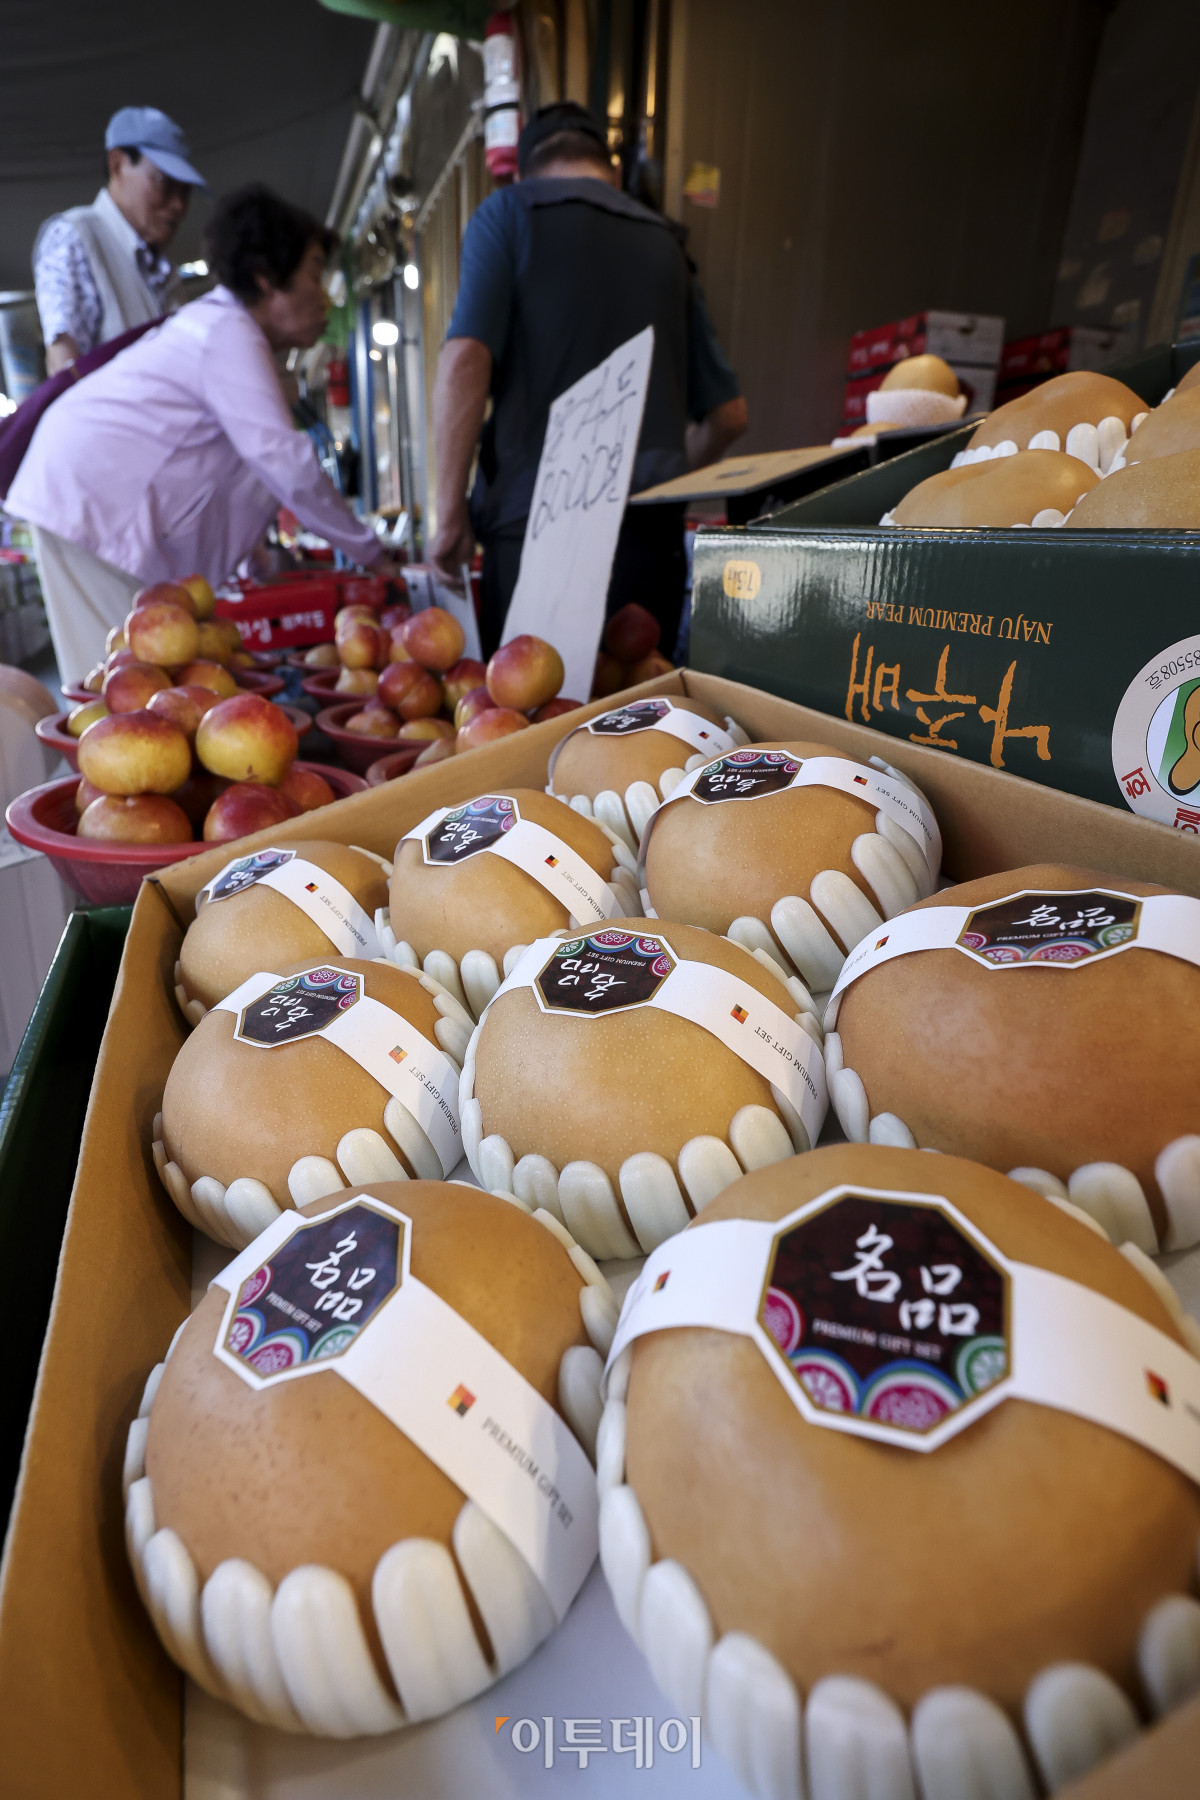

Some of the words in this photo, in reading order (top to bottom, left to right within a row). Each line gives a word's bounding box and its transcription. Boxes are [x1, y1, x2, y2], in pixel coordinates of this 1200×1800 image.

[866, 602, 903, 624] PEAR
[908, 607, 994, 636] PREMIUM
[998, 614, 1053, 644] NAJU
[845, 632, 1052, 768] 나주배
[876, 786, 891, 797] SET
[892, 796, 908, 810] GIFT
[440, 822, 483, 853] 名品
[909, 809, 933, 842] PREMIUM
[561, 871, 574, 883] SET
[320, 895, 333, 906] SET
[574, 882, 588, 897] GIFT
[331, 906, 344, 921] GIFT
[1011, 904, 1115, 931] 名品
[343, 919, 368, 947] PREMIUM
[997, 933, 1041, 942] PREMIUM
[1042, 931, 1066, 939] GIFT
[586, 951, 600, 959] SET
[599, 954, 616, 963] GIFT
[617, 958, 647, 967] PREMIUM
[558, 959, 627, 1001] 名品
[260, 995, 314, 1032] 名品
[754, 1026, 773, 1043] SET
[772, 1041, 794, 1061] GIFT
[409, 1066, 426, 1081] SET
[793, 1059, 818, 1100] PREMIUM
[424, 1081, 441, 1099] GIFT
[438, 1098, 459, 1135] PREMIUM
[305, 1230, 376, 1322] 名品
[830, 1223, 980, 1336] 名品
[812, 1318, 877, 1346] PREMIUM
[879, 1333, 914, 1353] GIFT
[914, 1341, 943, 1361] SET
[482, 1416, 539, 1480] PREMIUM
